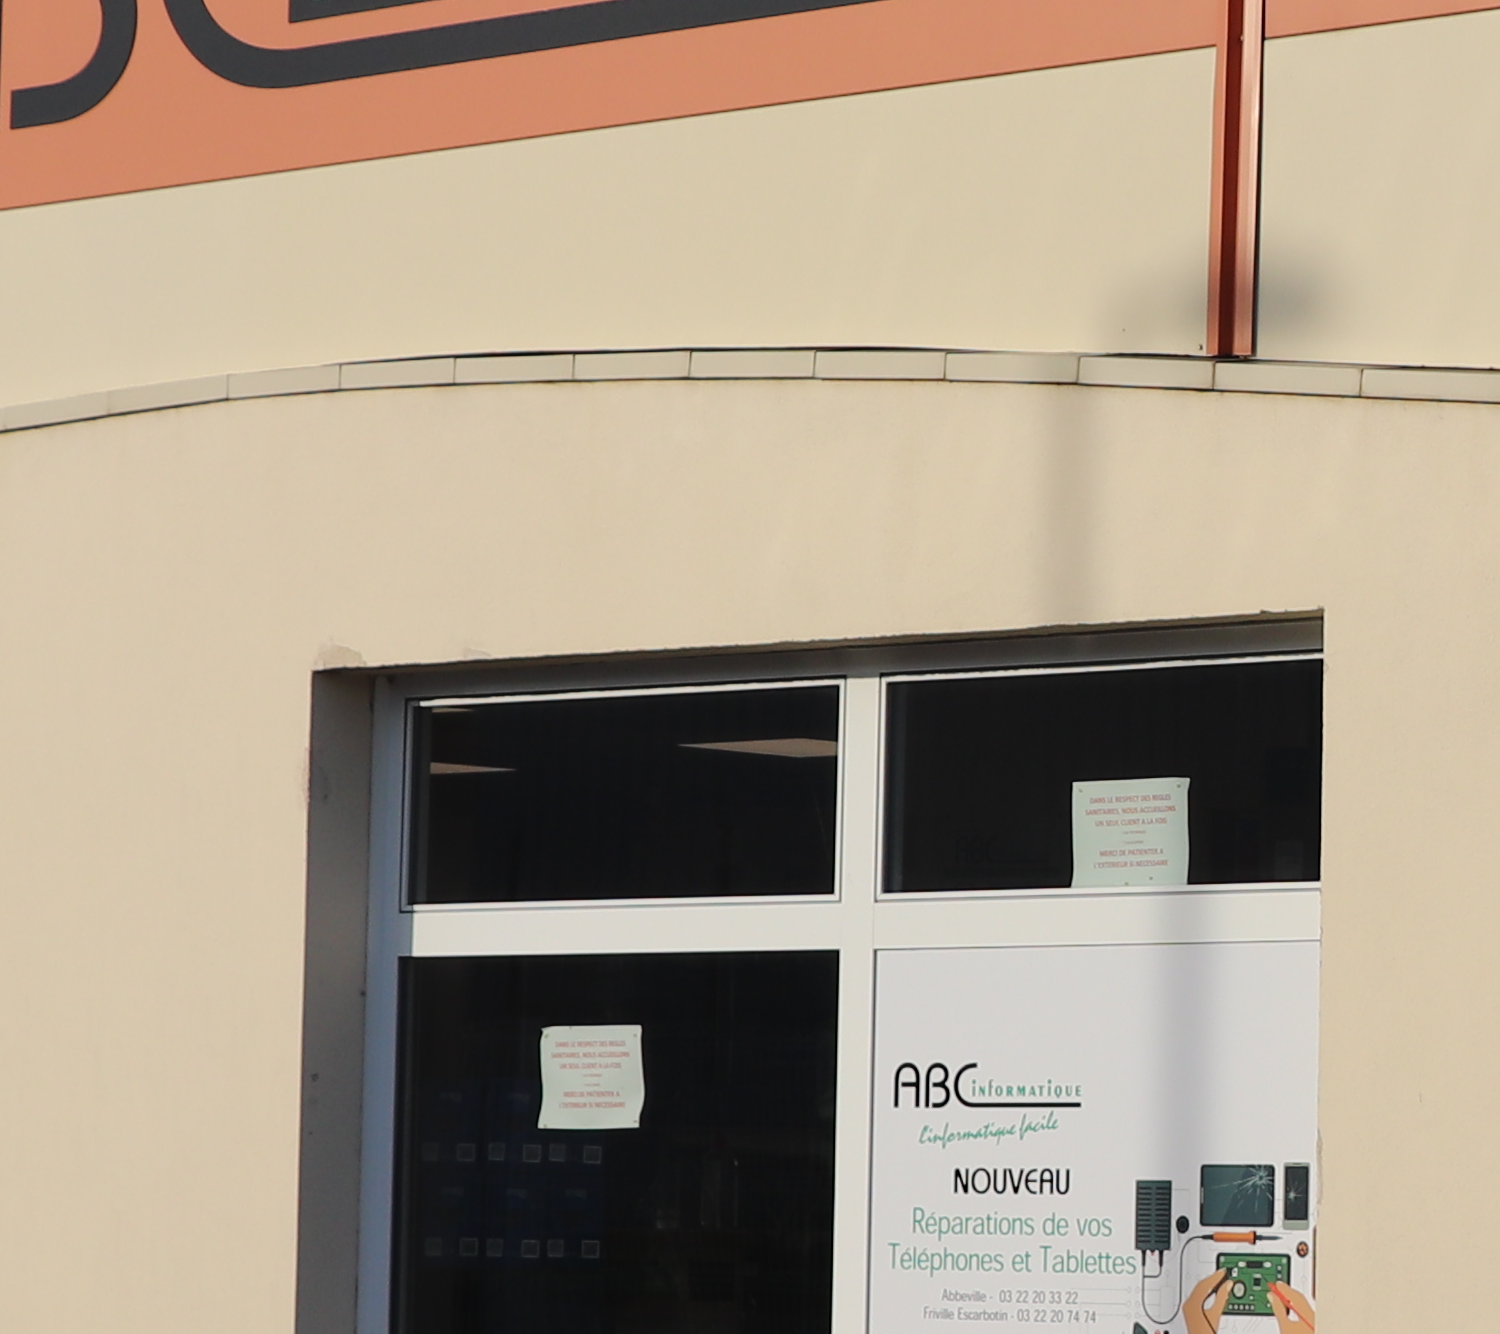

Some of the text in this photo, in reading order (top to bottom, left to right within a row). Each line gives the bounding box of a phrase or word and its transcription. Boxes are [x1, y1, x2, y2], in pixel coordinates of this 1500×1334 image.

[893, 1062, 979, 1108] ABC
[918, 1110, 1059, 1150] l'informatique facile
[953, 1168, 1071, 1195] NOUVEAU
[911, 1206, 1113, 1242] Réparations de vos
[887, 1242, 1138, 1278] Téléphones et Tablettes
[941, 1288, 987, 1303] Abbeville
[999, 1290, 1012, 1303] 03
[1015, 1291, 1029, 1304] 22
[1032, 1291, 1046, 1304] 20
[1048, 1291, 1062, 1305] 33
[1065, 1291, 1079, 1305] 22
[923, 1306, 955, 1320] Friville
[957, 1307, 1008, 1322] Escarbotin
[1016, 1310, 1030, 1322] 03
[1033, 1310, 1047, 1323] 22
[1050, 1310, 1064, 1323] 20
[1067, 1310, 1080, 1323] 74
[1083, 1310, 1097, 1324] 74
